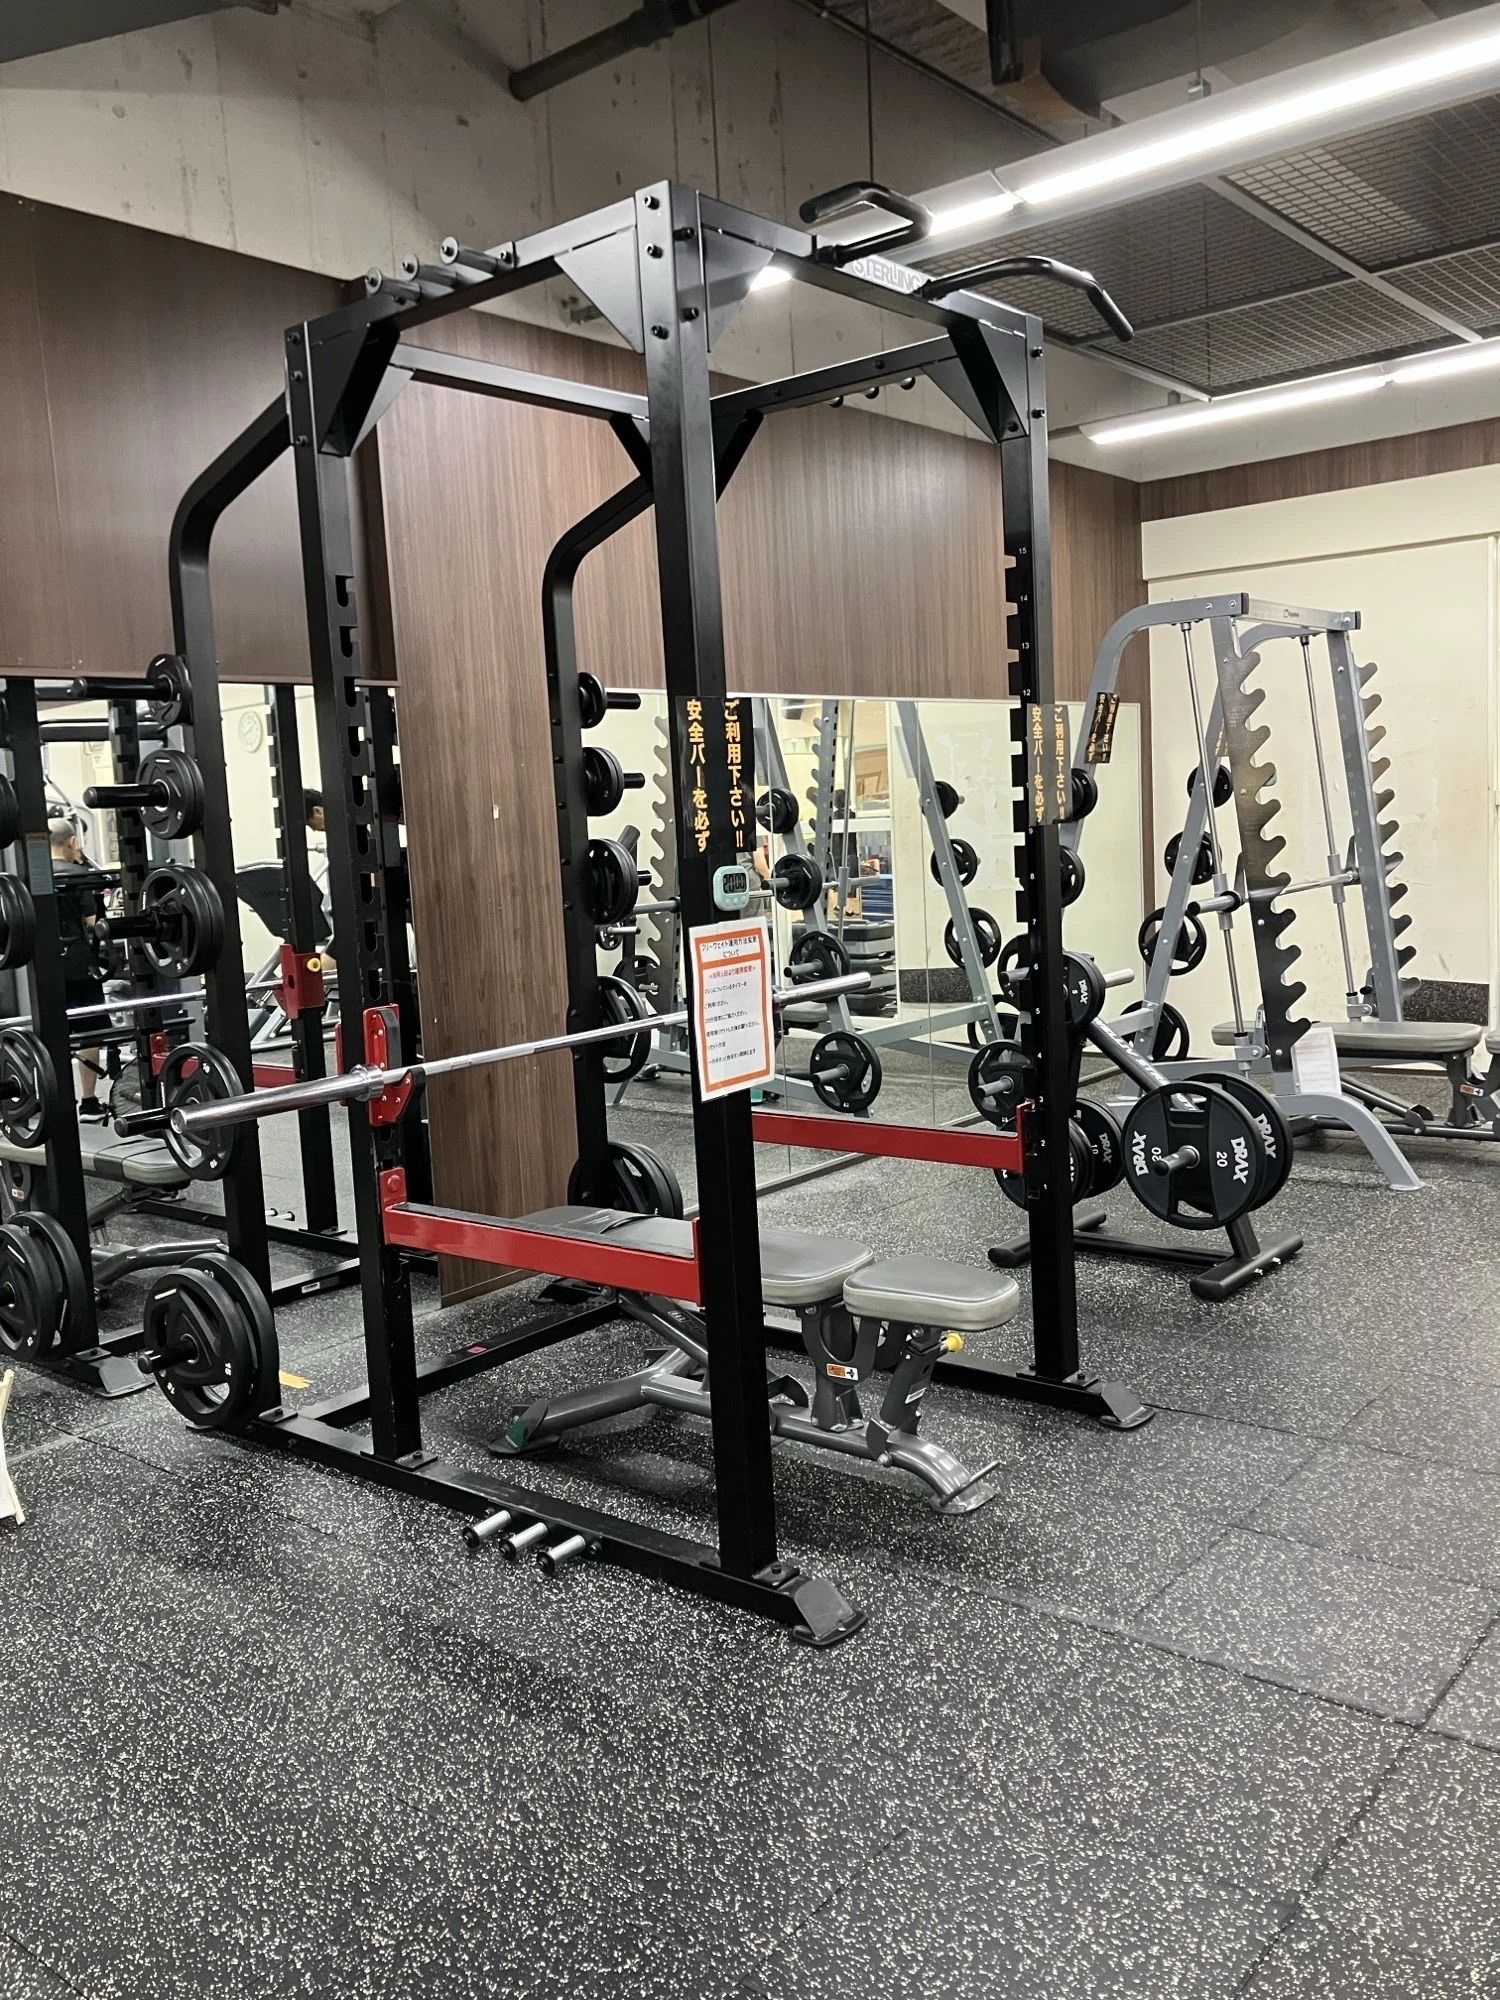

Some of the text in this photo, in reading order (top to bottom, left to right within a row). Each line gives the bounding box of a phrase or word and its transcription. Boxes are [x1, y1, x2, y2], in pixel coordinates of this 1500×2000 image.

[1018, 547, 1027, 555] 15
[1020, 594, 1028, 602] 14
[1021, 642, 1030, 650] 13
[1022, 688, 1031, 697] 12
[686, 698, 711, 853] 安全バーを必ず
[1031, 705, 1045, 823] 安全バーを必ず
[1078, 979, 1089, 1005] DRAX
[1091, 1132, 1112, 1164] 10 DRAX
[1254, 1113, 1277, 1159] DRAX
[1132, 1131, 1162, 1176] DRAX 20
[1216, 1136, 1249, 1184] 20 DRAX
